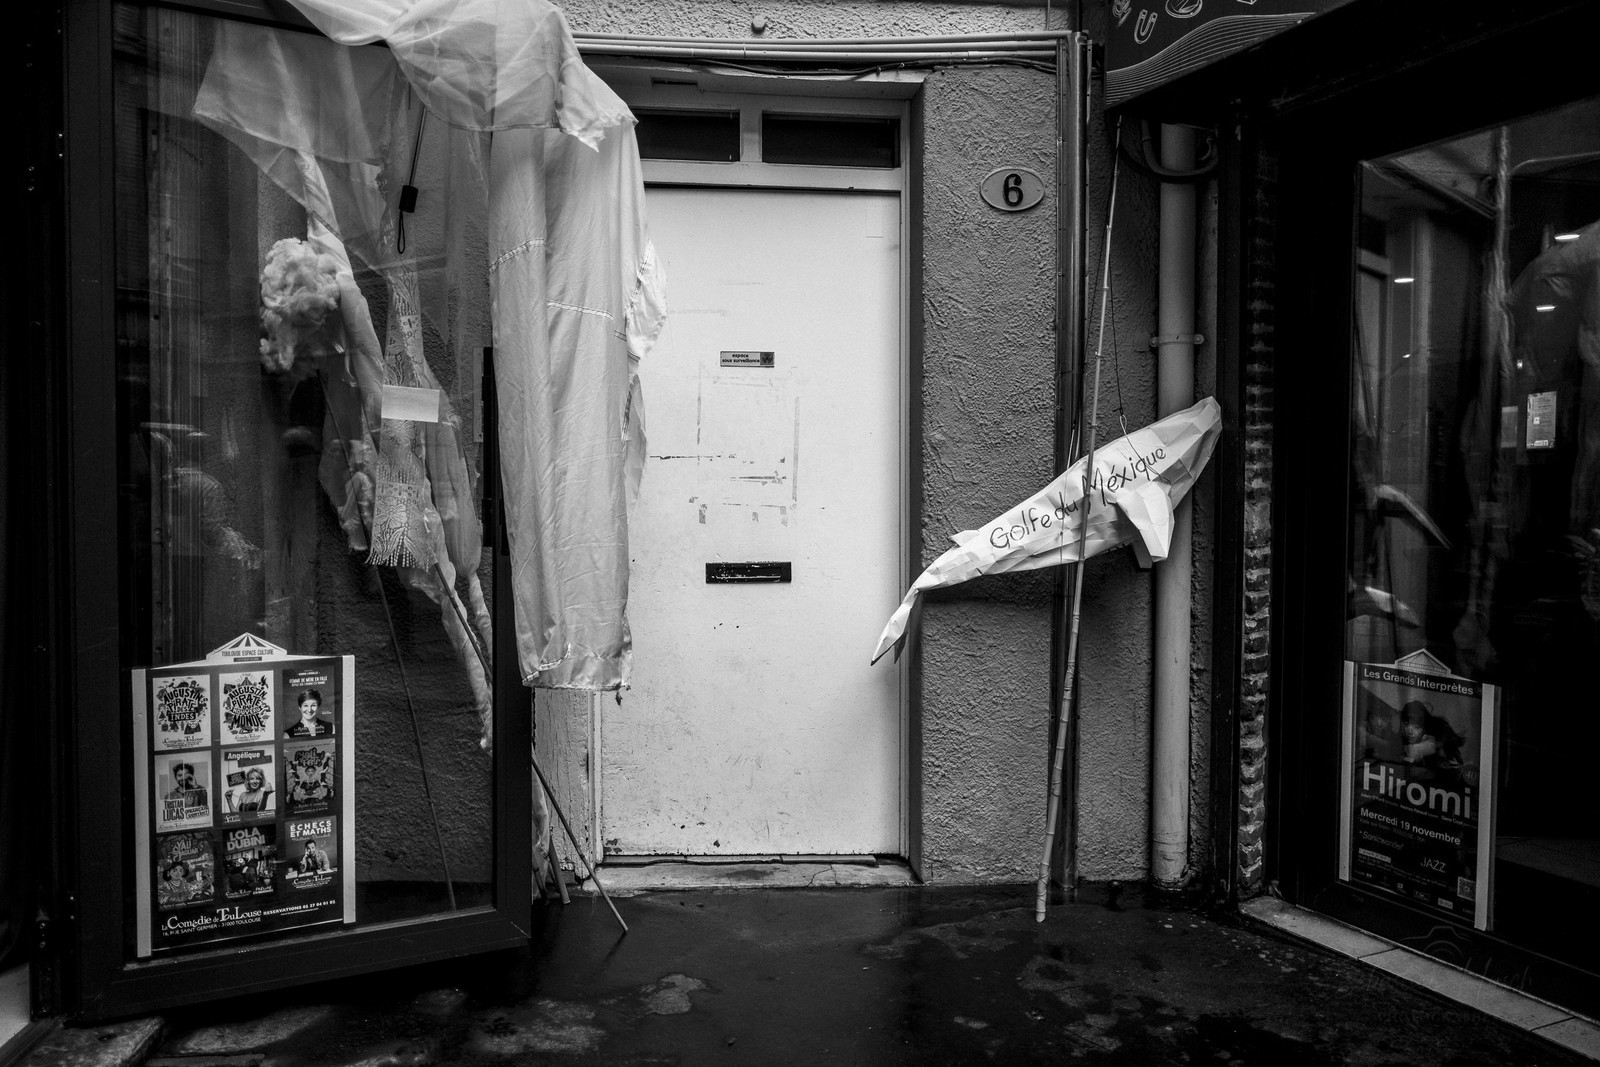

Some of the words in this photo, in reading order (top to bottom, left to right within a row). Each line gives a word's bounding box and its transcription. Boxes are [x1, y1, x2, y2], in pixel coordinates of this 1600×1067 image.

[1003, 173, 1023, 207] 6
[989, 507, 1053, 549] Golfe
[1054, 491, 1079, 521] du
[1081, 446, 1167, 515] Méxique
[257, 648, 274, 656] CULTURE
[1363, 668, 1381, 679] Les
[1382, 671, 1415, 686] Grands
[1417, 677, 1474, 696] Interprètes
[164, 688, 203, 705] AUGUSTIN
[228, 686, 268, 700] AUGUSTIN
[167, 698, 196, 713] PIRATE
[231, 694, 261, 708] PIRATE
[229, 713, 266, 730] MONDE
[228, 752, 261, 761] Angélique
[1362, 761, 1471, 819] Hiromi
[163, 807, 185, 821] LUCAS
[290, 820, 332, 832] ÉCHECS
[302, 826, 332, 836] MATHS
[1360, 807, 1398, 827] Mercredi
[1400, 820, 1411, 831] 19
[1412, 825, 1461, 846] novembre
[229, 827, 260, 841] LOLA
[226, 834, 266, 851] DUBINI
[1420, 856, 1447, 874] JAZZ
[262, 905, 302, 916] RESERVATIONS
[196, 924, 218, 932] GERMIER
[235, 917, 261, 925] TOULOUSE
